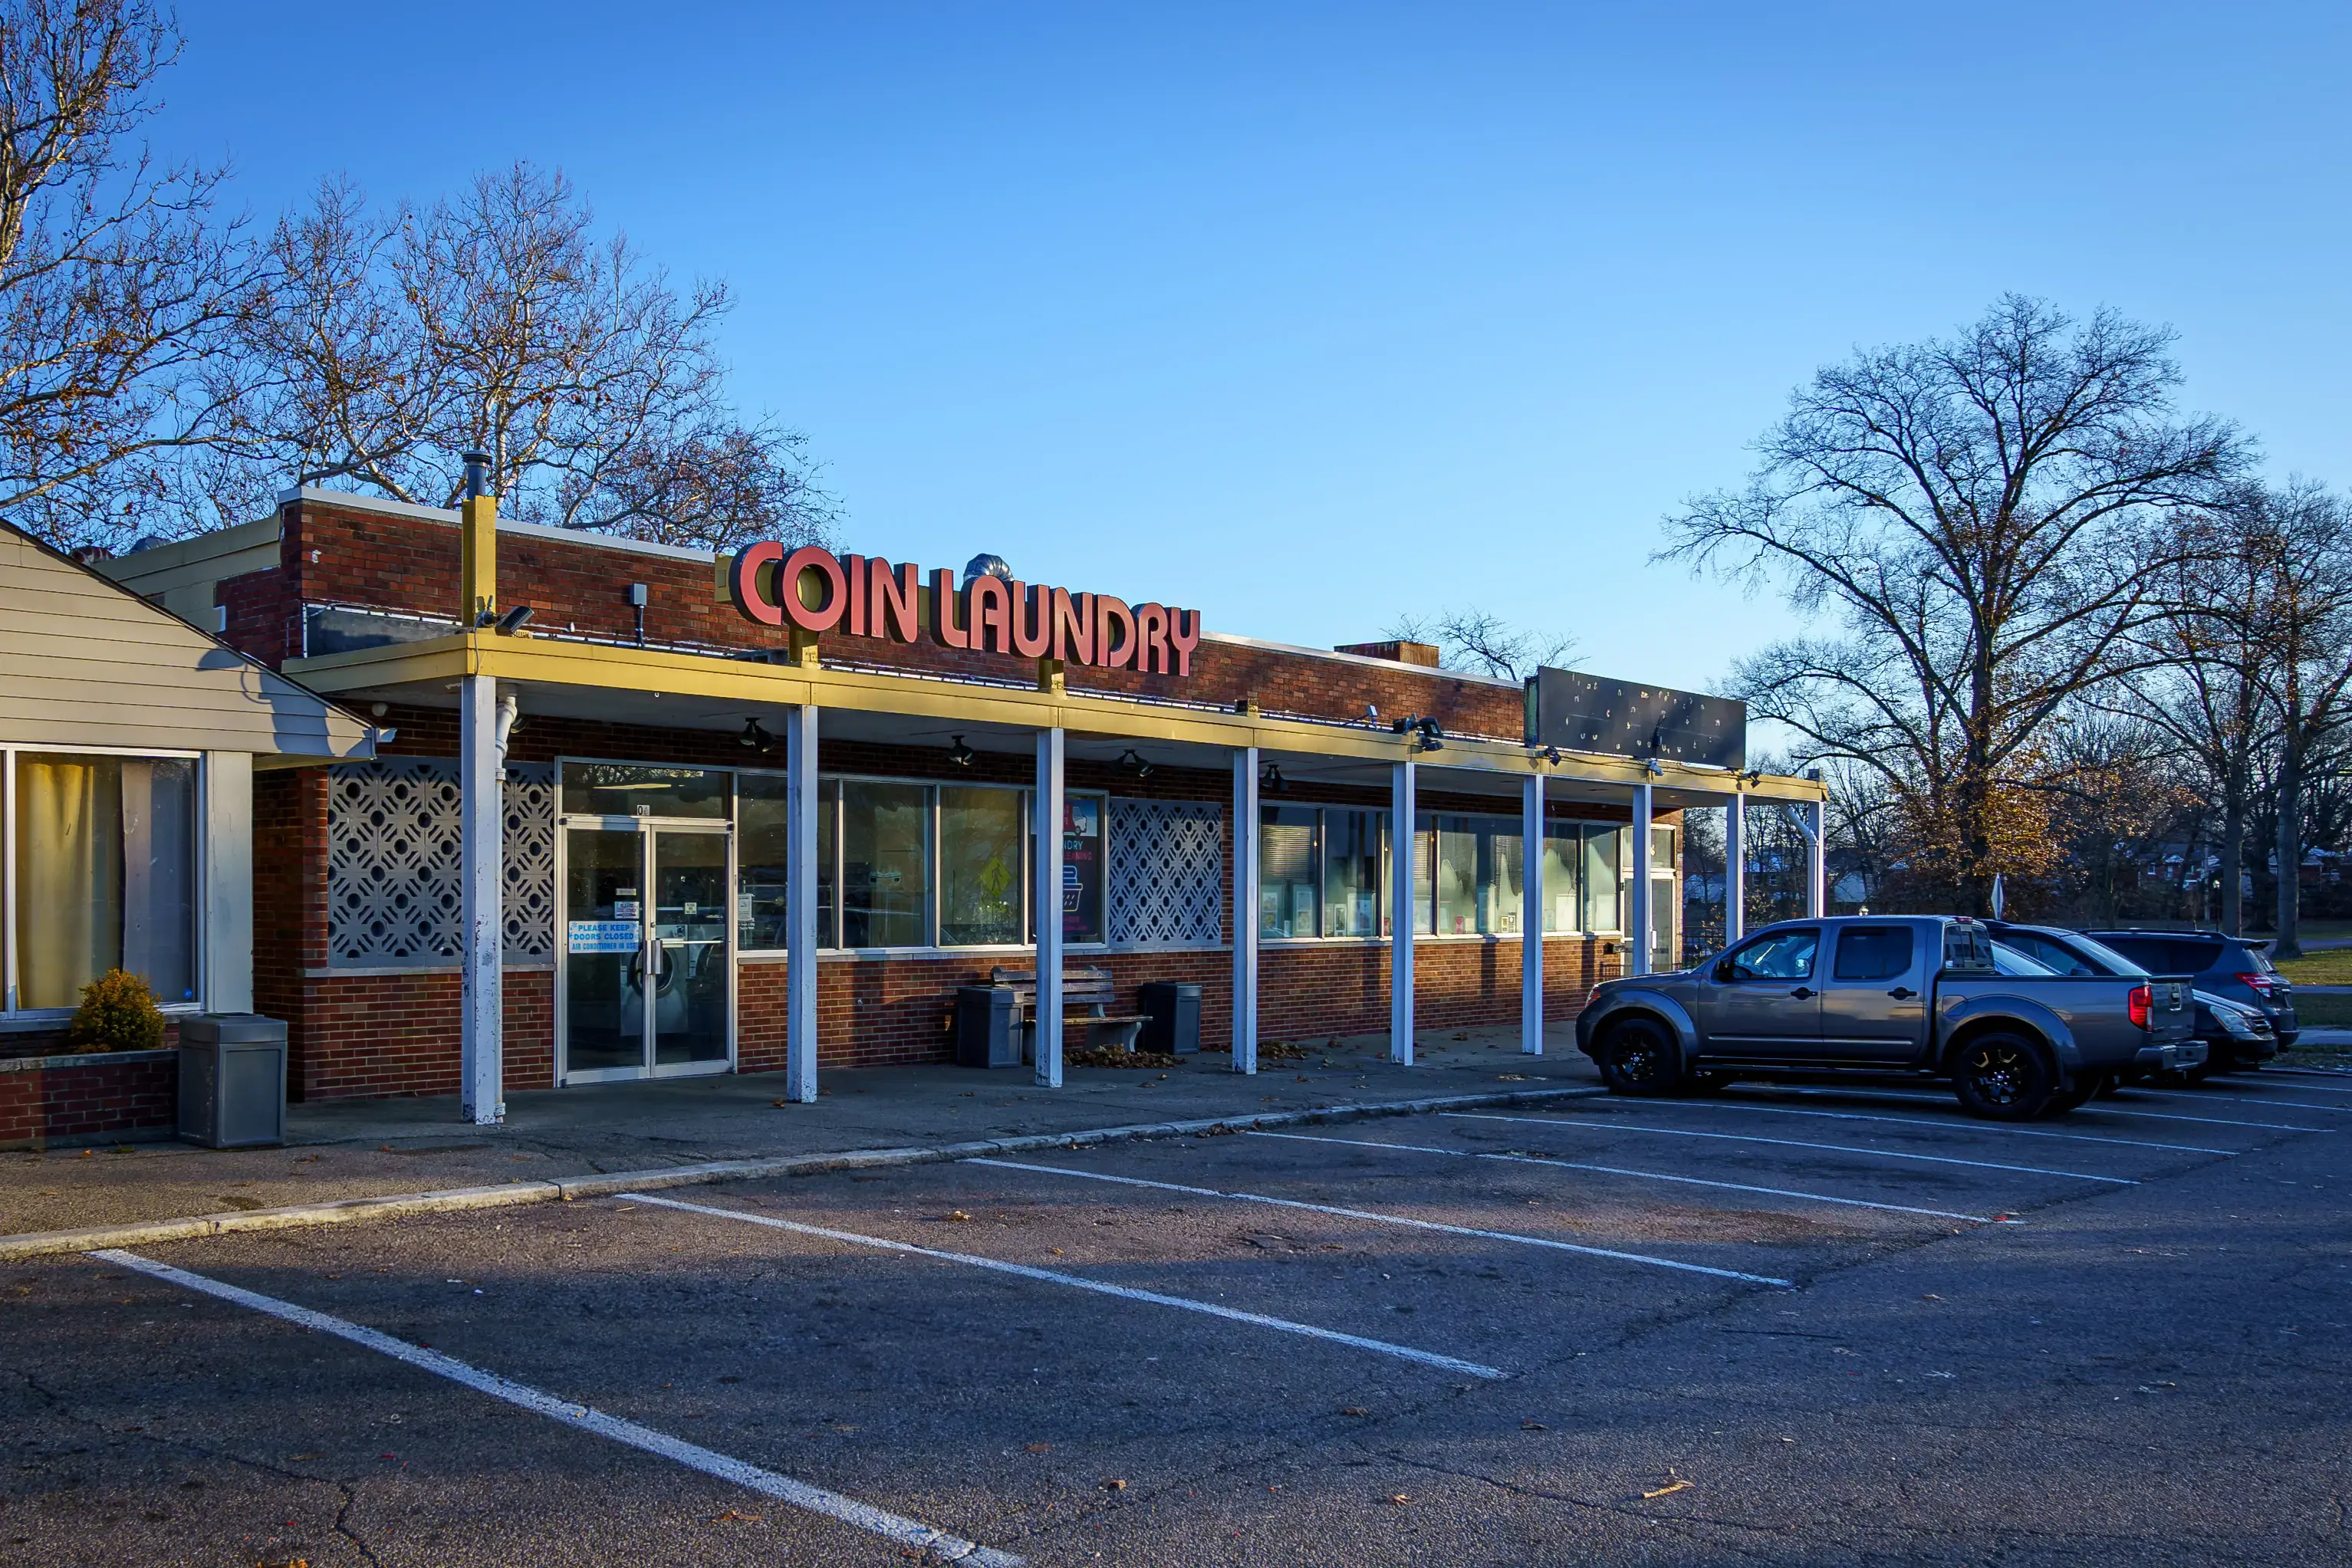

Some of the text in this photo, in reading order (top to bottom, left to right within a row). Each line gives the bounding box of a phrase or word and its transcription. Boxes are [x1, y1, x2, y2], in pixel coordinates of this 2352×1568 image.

[732, 540, 1200, 676] COIN LAUNDRY
[1064, 840, 1084, 850] NDRY
